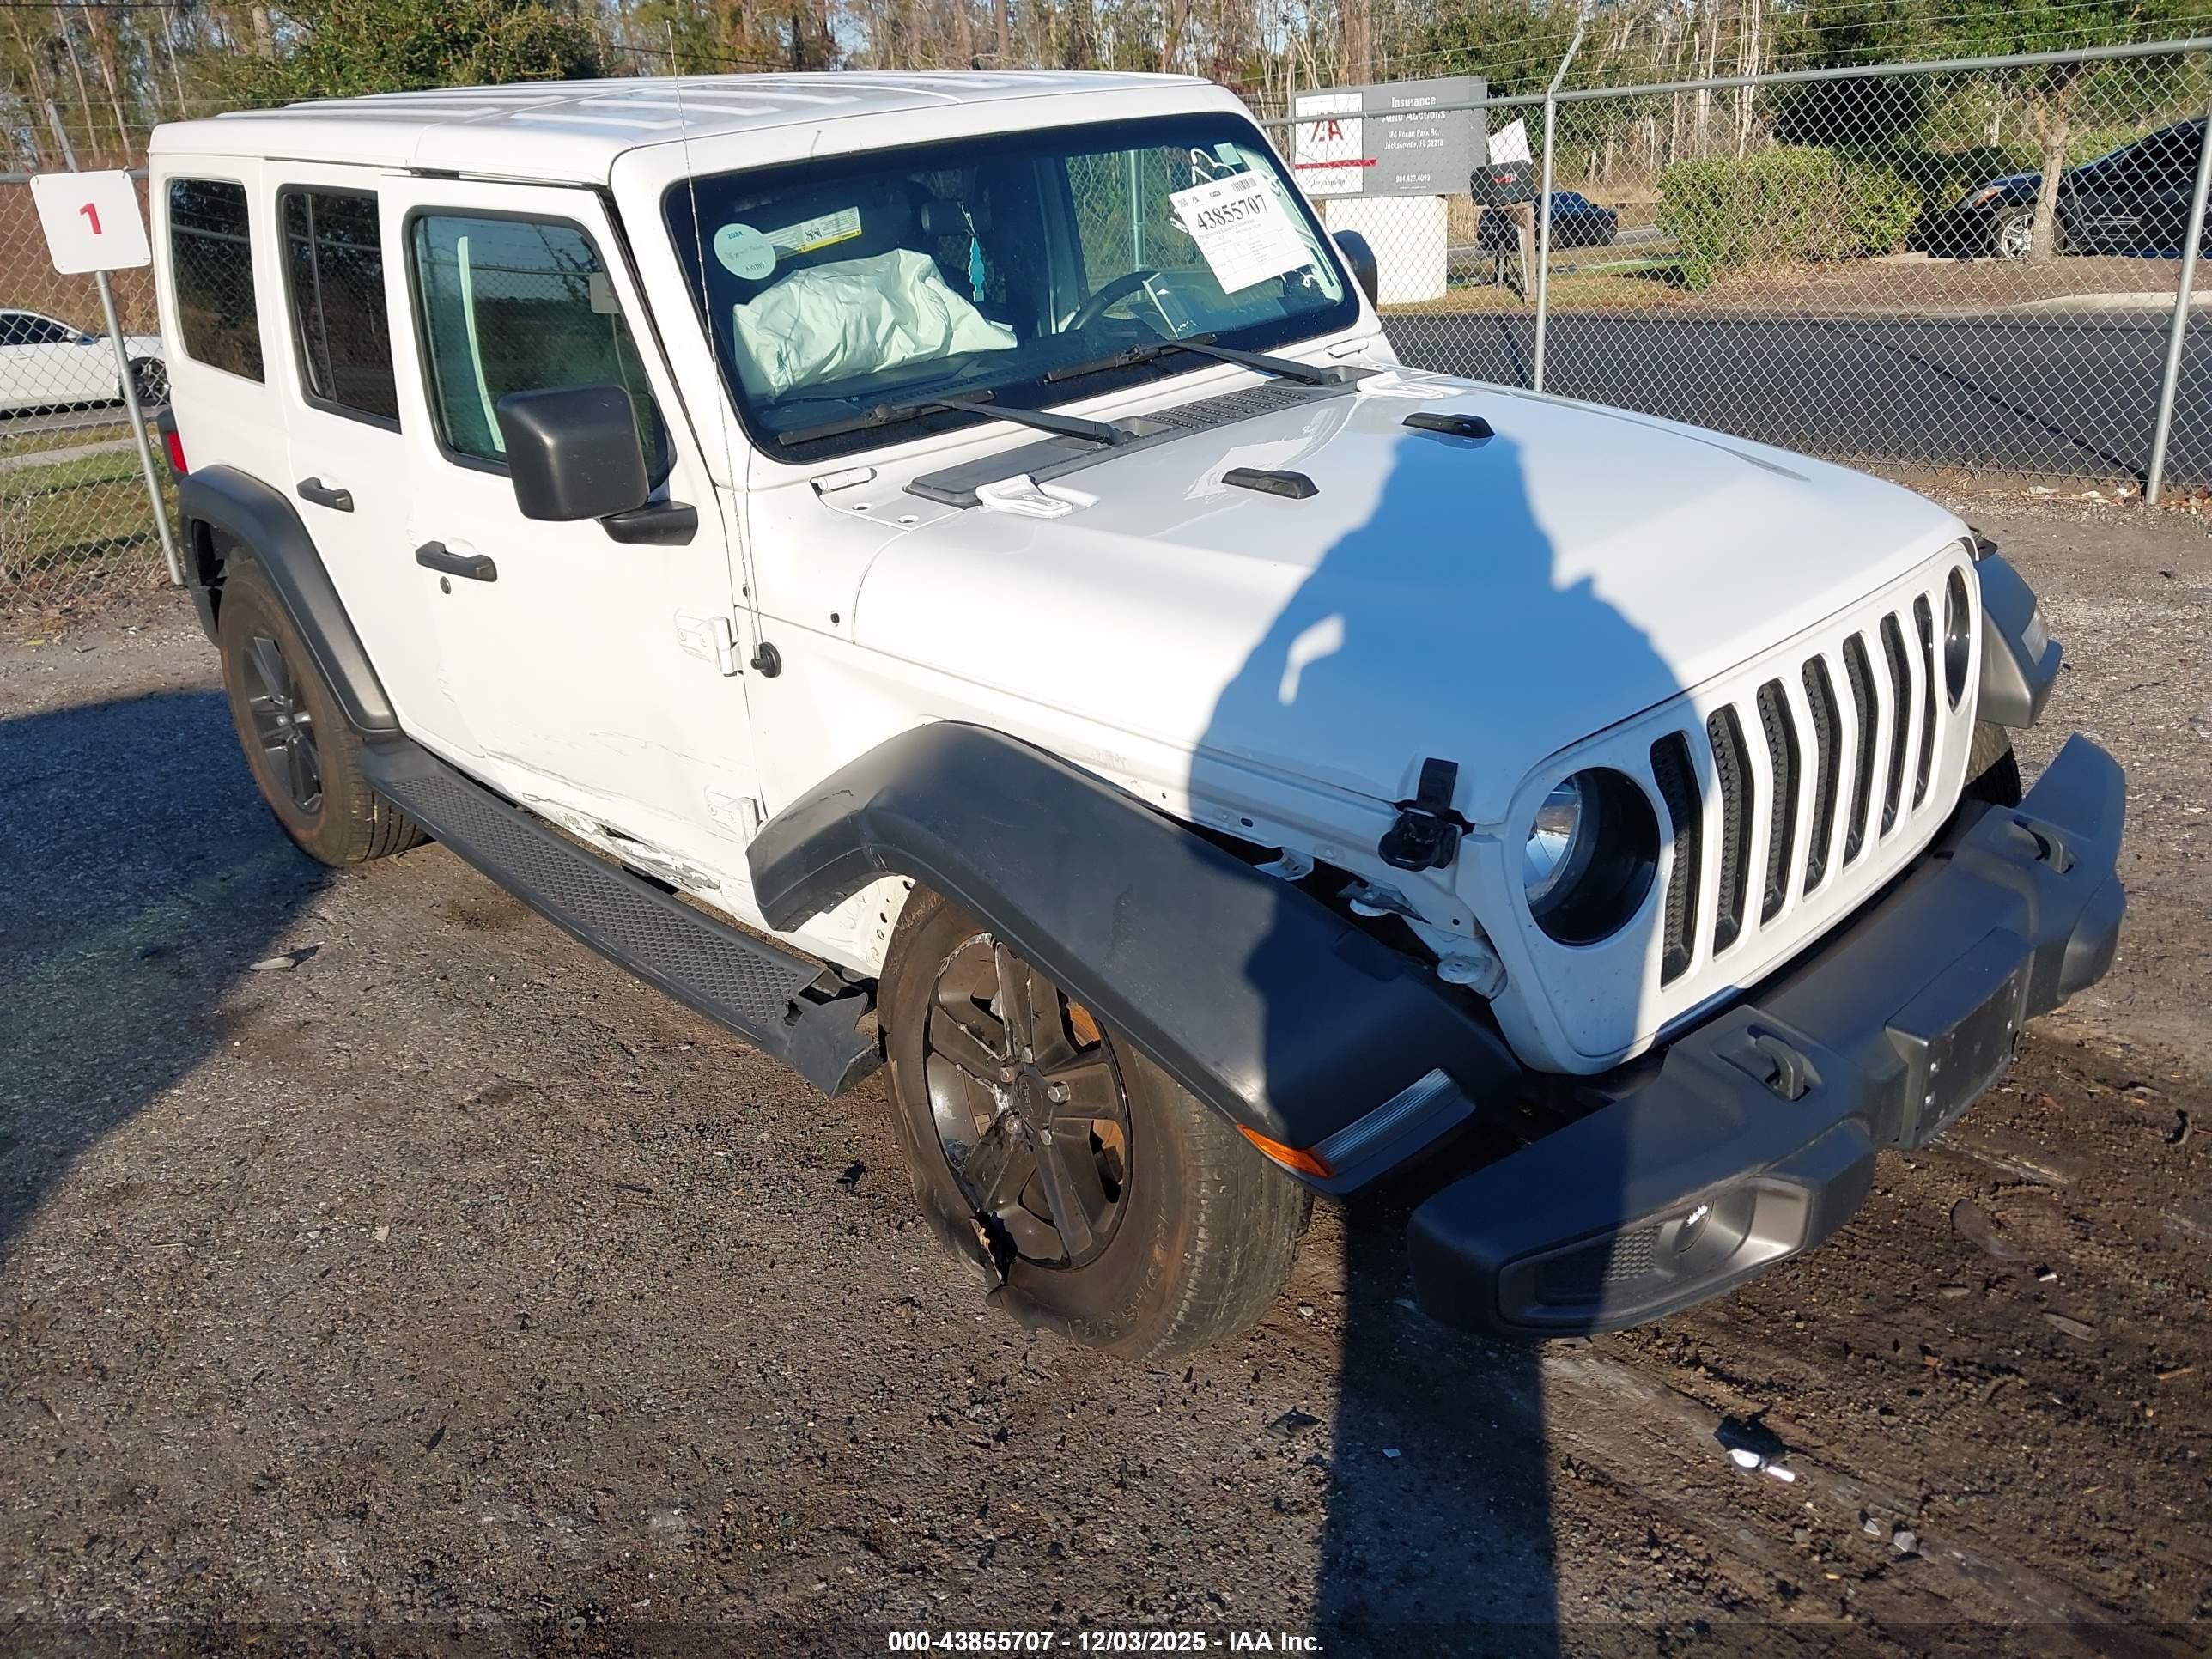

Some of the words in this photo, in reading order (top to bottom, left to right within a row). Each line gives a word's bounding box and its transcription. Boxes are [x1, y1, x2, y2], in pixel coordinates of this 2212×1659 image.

[1391, 96, 1437, 108] Insurance
[79, 203, 102, 234] 1
[1197, 194, 1267, 230] 43855707
